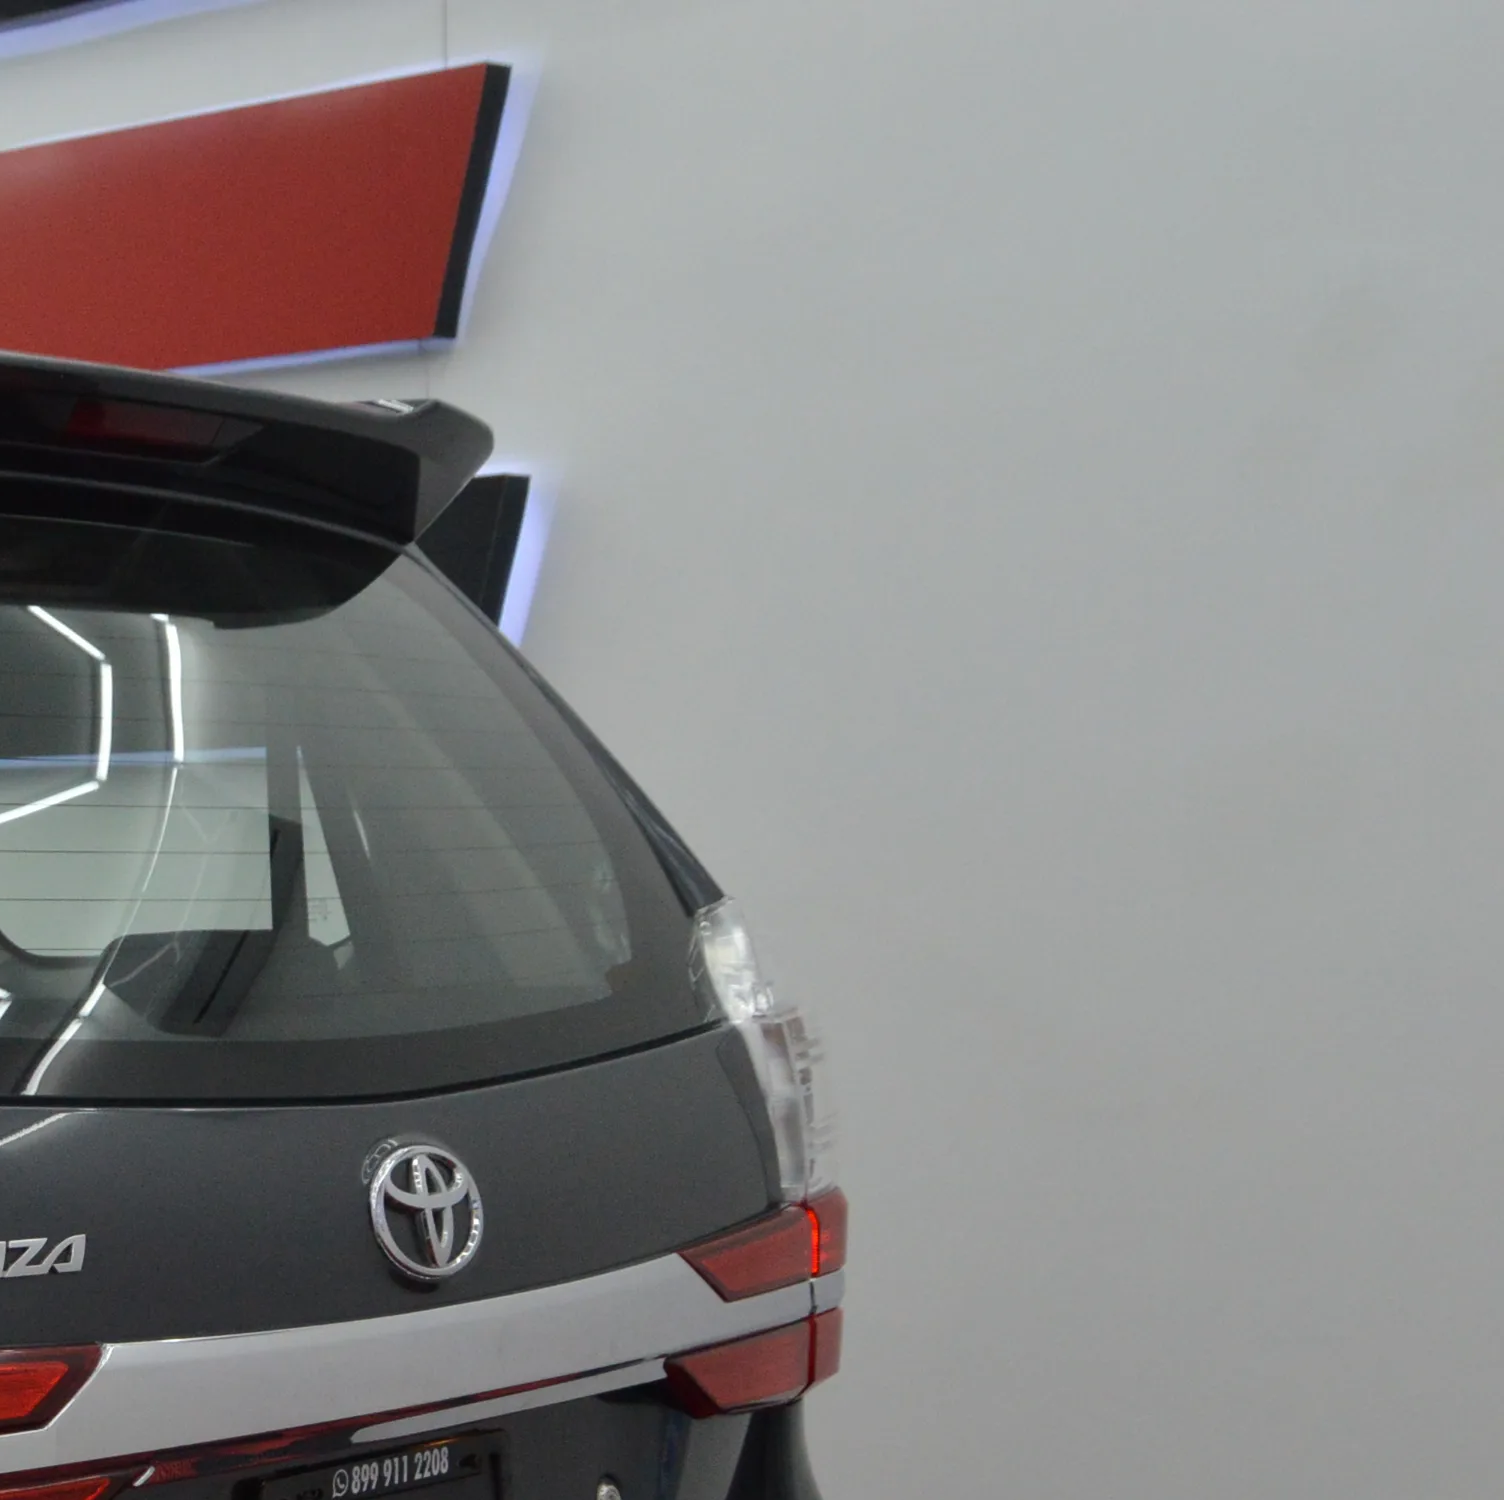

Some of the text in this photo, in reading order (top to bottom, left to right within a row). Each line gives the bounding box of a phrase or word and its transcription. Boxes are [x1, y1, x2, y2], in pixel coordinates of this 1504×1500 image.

[351, 1446, 450, 1494] 899 911 2208
